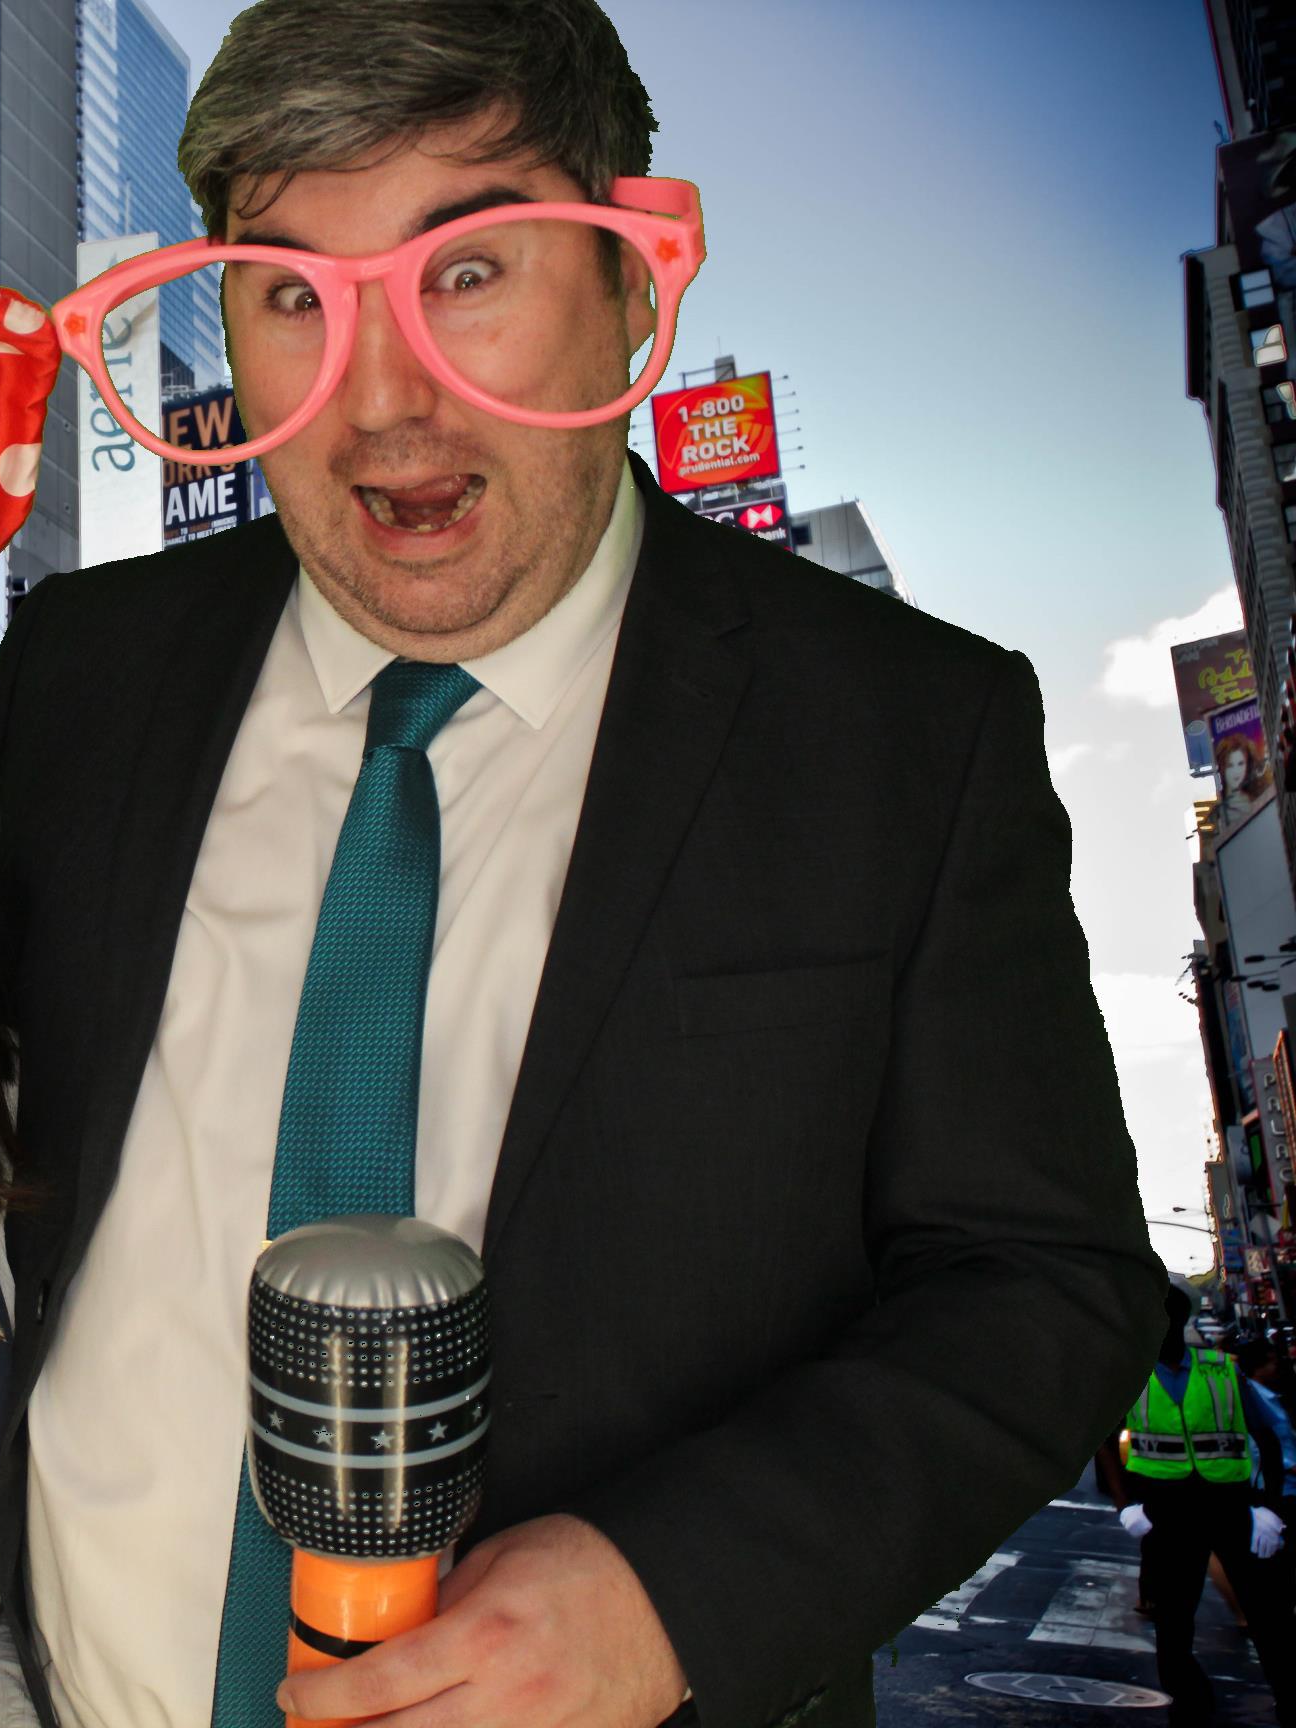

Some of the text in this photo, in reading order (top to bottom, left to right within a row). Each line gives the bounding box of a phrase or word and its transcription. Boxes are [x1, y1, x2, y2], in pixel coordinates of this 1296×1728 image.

[162, 396, 235, 450] EW
[678, 395, 745, 424] 1-800
[688, 417, 738, 443] THE
[680, 434, 751, 465] ROCK
[678, 453, 761, 477] prudential.com
